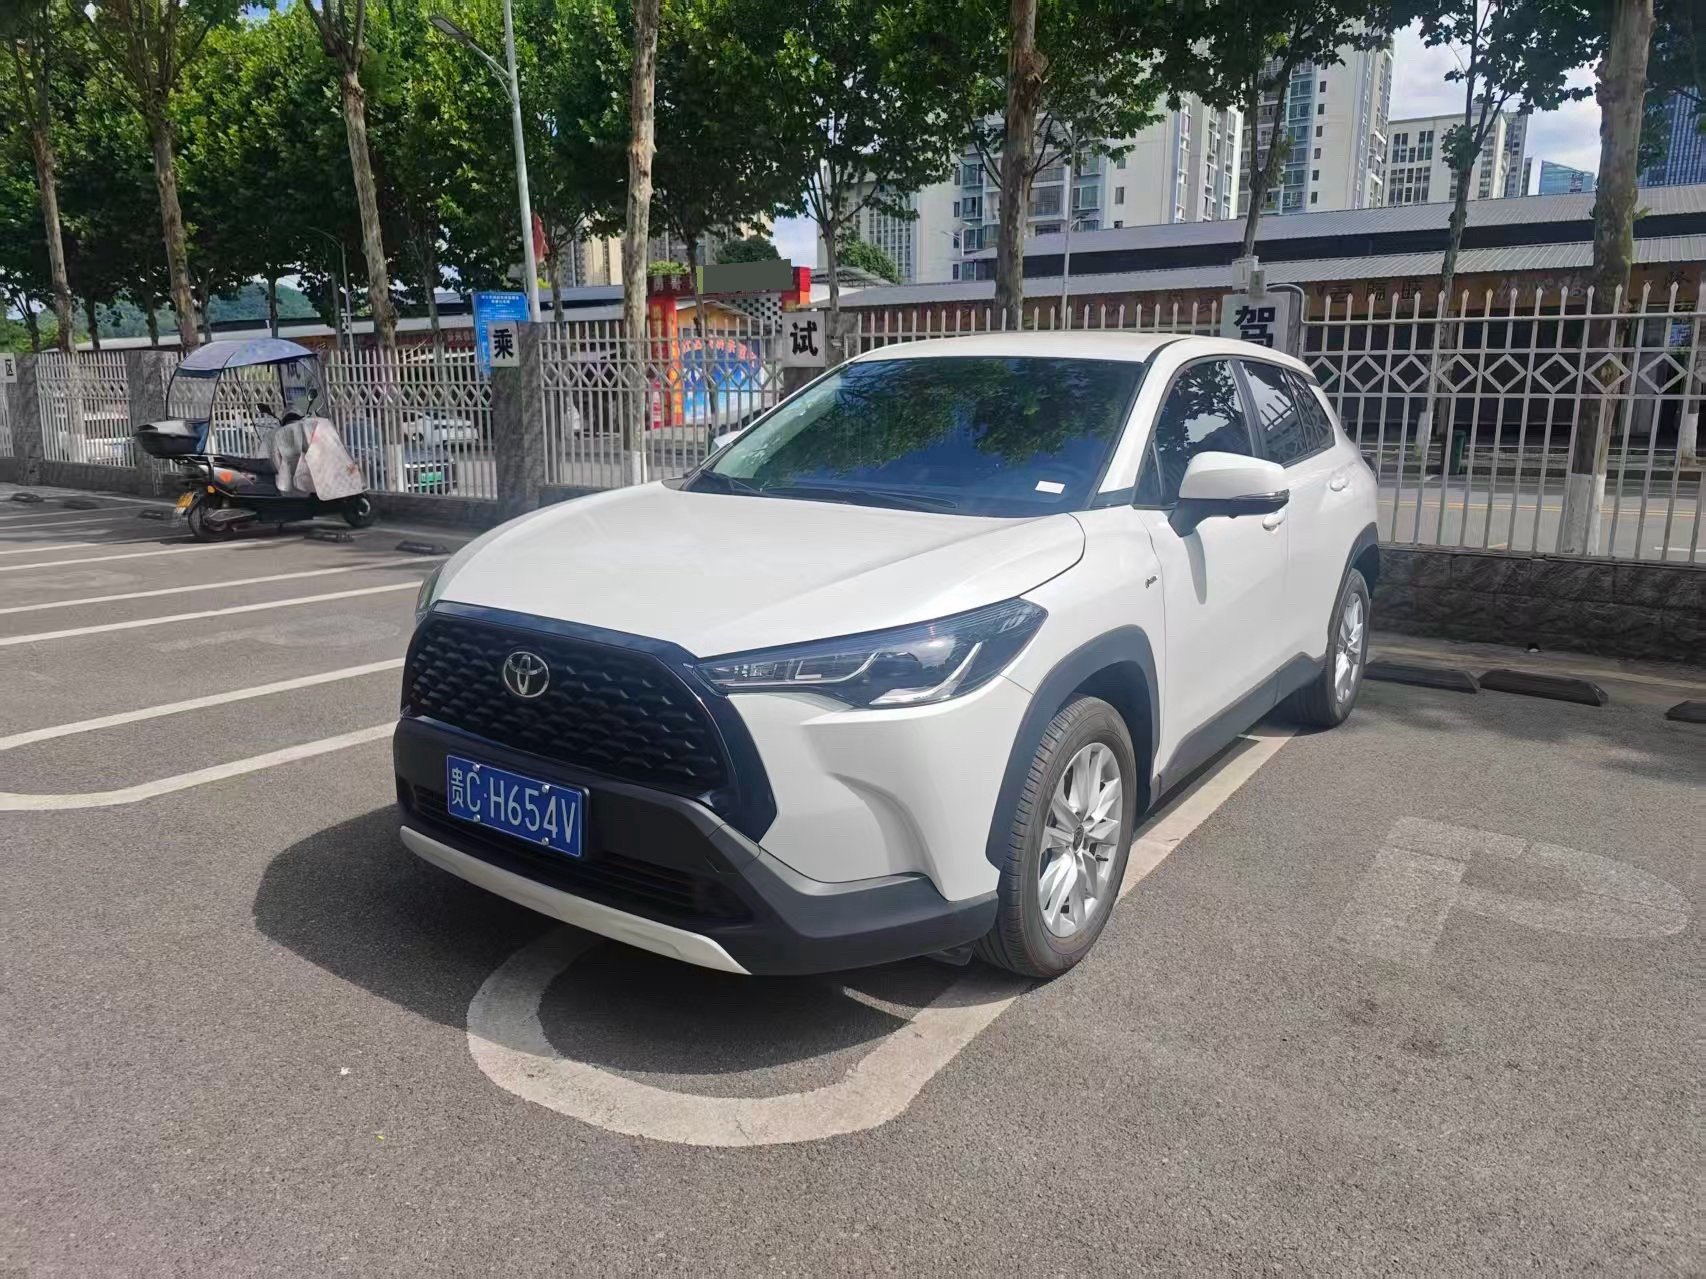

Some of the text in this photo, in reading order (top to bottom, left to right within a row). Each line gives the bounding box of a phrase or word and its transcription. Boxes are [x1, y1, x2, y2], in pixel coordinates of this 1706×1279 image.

[493, 328, 514, 359] 乘
[790, 320, 819, 356] 试
[1233, 305, 1276, 348] 驾
[451, 767, 576, 844] 贵C·H654V
